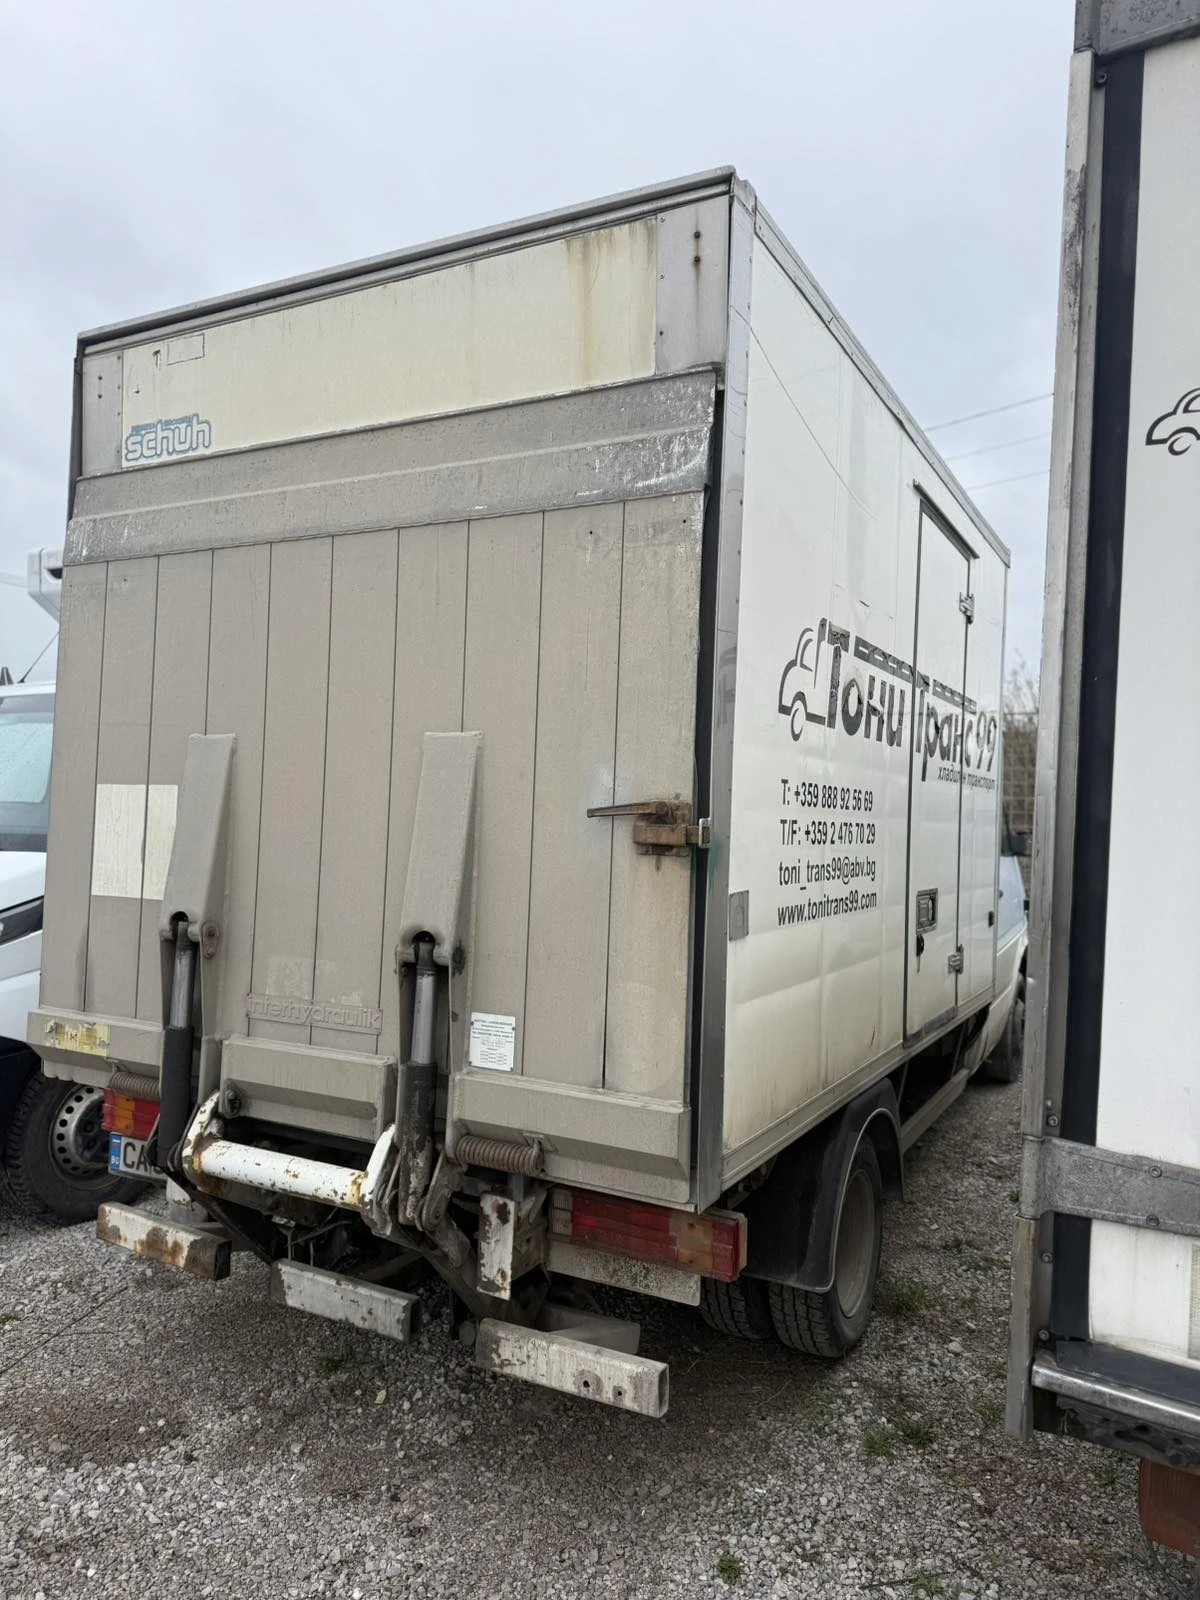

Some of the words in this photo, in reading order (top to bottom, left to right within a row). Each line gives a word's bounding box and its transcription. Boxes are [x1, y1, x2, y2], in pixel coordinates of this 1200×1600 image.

[125, 413, 211, 461] schuh
[781, 778, 791, 806] T:
[794, 782, 819, 808] +359
[821, 785, 838, 810] 888
[840, 787, 851, 811] 92
[852, 789, 862, 811] 56
[864, 790, 873, 812] 69
[780, 819, 801, 846] T/F:
[804, 820, 828, 846] +359
[830, 821, 836, 845] 2
[838, 821, 853, 845] 476
[855, 823, 865, 844] 70
[866, 823, 876, 845] 29
[778, 856, 876, 891] toni_trans99@abv.bg
[777, 889, 877, 926] www.tonitrans99.com
